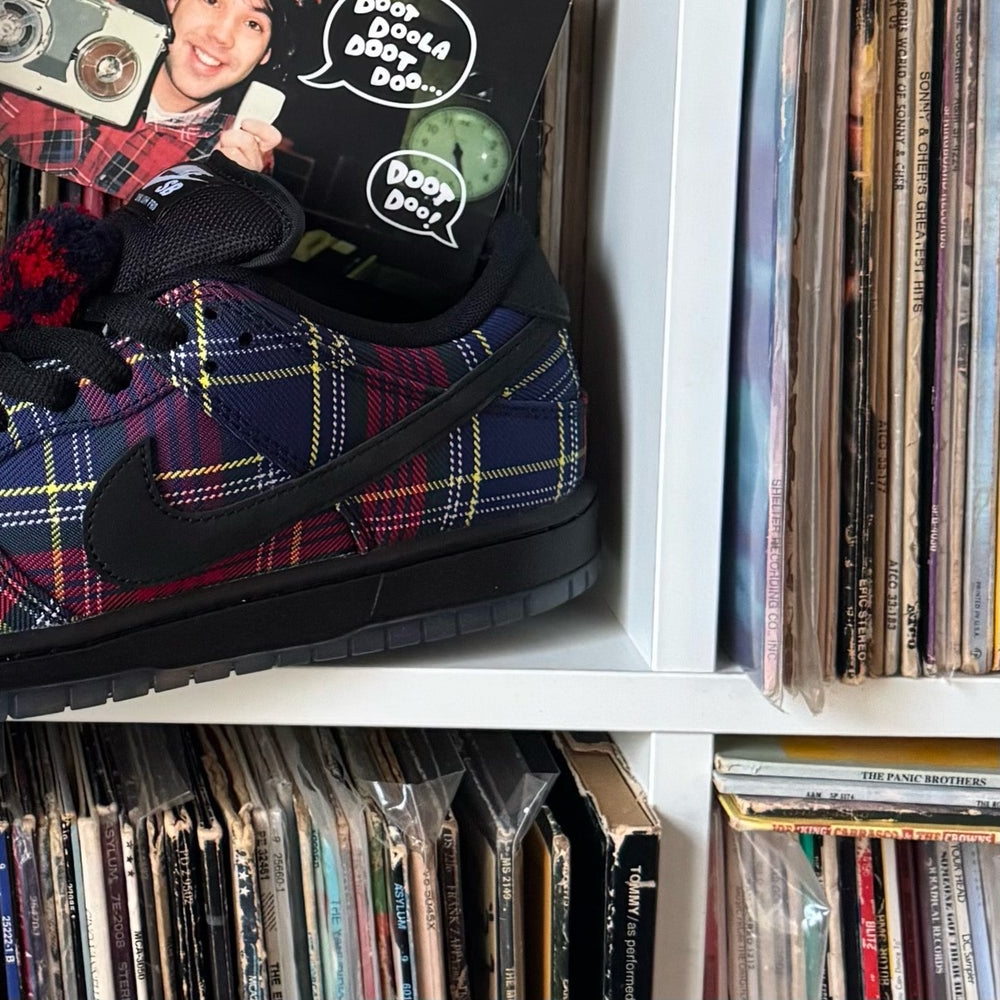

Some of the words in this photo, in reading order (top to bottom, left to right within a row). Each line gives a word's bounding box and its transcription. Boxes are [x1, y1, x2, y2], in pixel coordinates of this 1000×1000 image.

[344, 33, 418, 72] DOOT
[367, 16, 451, 61] DOOLA
[896, 38, 908, 79] WORLD
[896, 84, 908, 99] OF
[918, 72, 931, 123] SONNY
[895, 104, 906, 145] SONNY
[919, 128, 929, 137] &
[155, 179, 184, 196] SB
[387, 159, 456, 207] DOOT
[916, 143, 928, 195] CHER'S
[384, 188, 442, 230] DOO!
[912, 280, 925, 313] HITS
[858, 579, 868, 608] EPIC
[887, 560, 899, 589] ATCO
[887, 594, 898, 630] 33-183
[857, 611, 868, 661] STEREO
[861, 771, 885, 782] THE
[886, 772, 923, 784] PANIC
[924, 774, 987, 787] BROTHERS
[104, 821, 119, 882] ASYLUM
[502, 857, 511, 874] MS
[182, 878, 193, 905] 9502
[274, 853, 285, 893] 25660-1
[503, 876, 512, 900] 2149
[394, 883, 407, 930] ASYLUM
[446, 885, 459, 923] FRANK
[627, 865, 642, 936] TOMMY/as
[929, 876, 939, 922] RADICAL
[1, 915, 14, 952] 25222-1
[110, 894, 125, 948] 7E-2008
[956, 874, 966, 903] HEAD
[965, 952, 975, 984] Sampler
[6, 955, 15, 963] B
[932, 925, 943, 974] RECORDS
[270, 962, 281, 986] THE
[505, 968, 515, 987] THE
[624, 939, 637, 1000] performed
